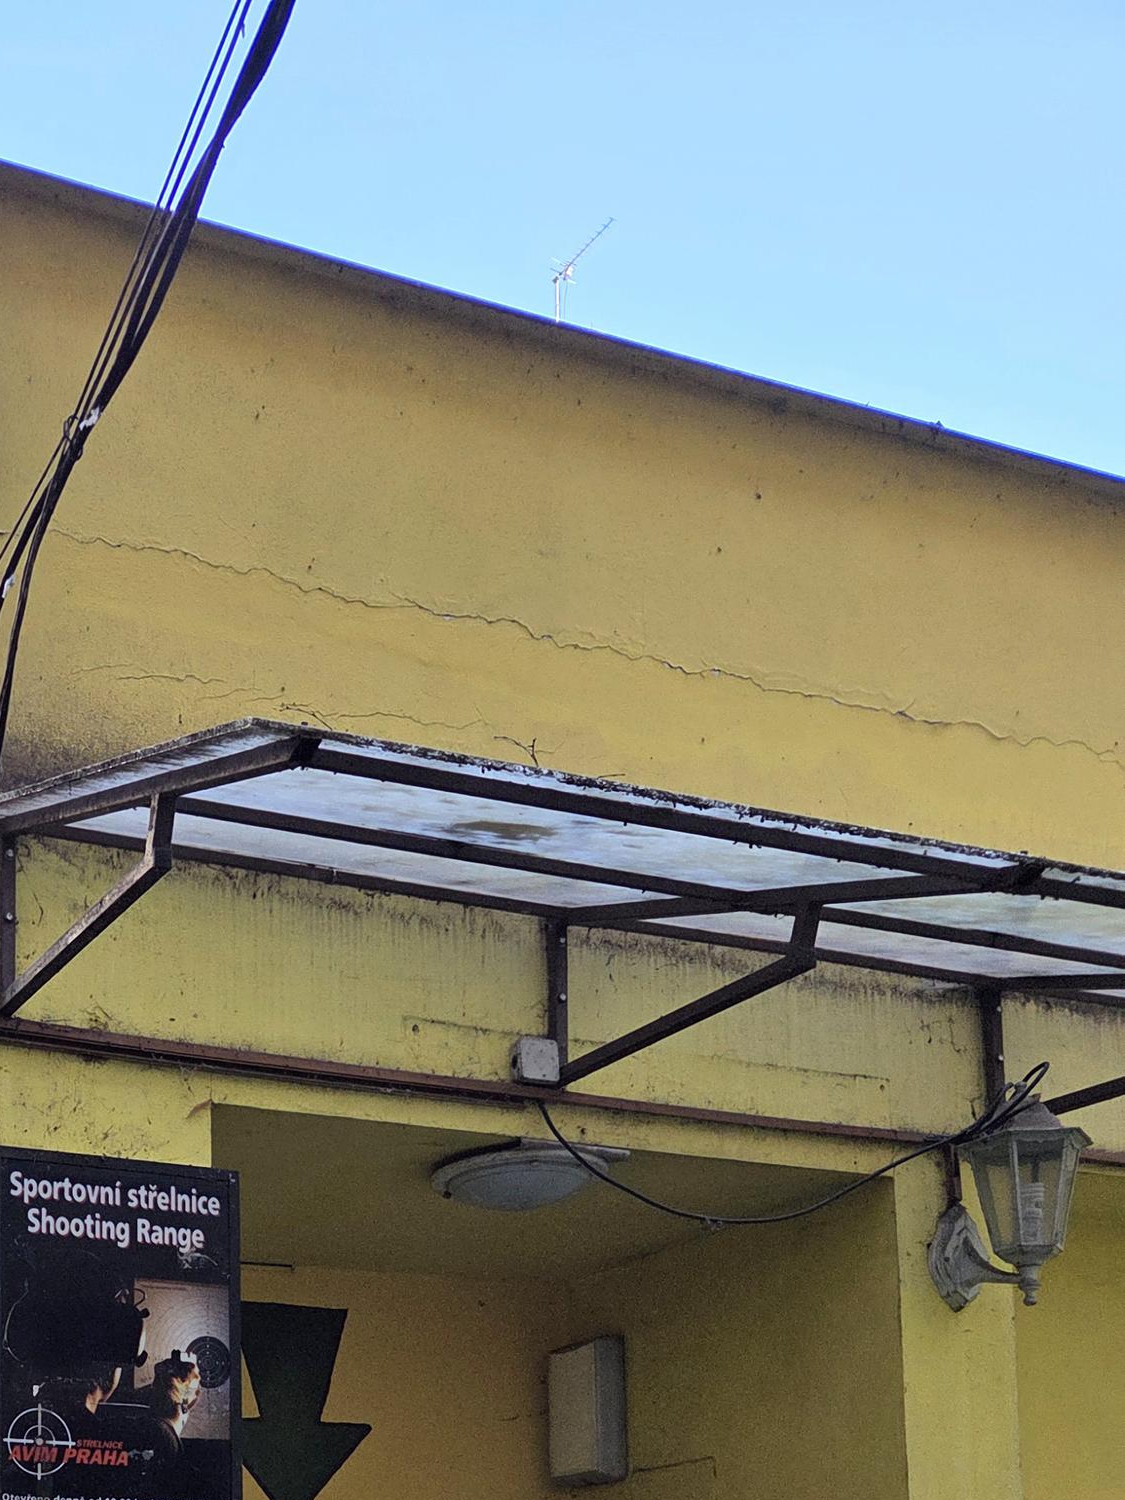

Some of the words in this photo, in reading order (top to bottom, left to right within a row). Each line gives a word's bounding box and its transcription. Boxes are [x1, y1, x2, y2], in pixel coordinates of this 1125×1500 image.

[9, 1170, 121, 1206] Sportovní
[127, 1184, 221, 1216] střelnice
[27, 1207, 130, 1248] Shooting
[136, 1218, 205, 1253] Range
[9, 1445, 58, 1462] AVIM
[63, 1448, 129, 1466] PRAHA
